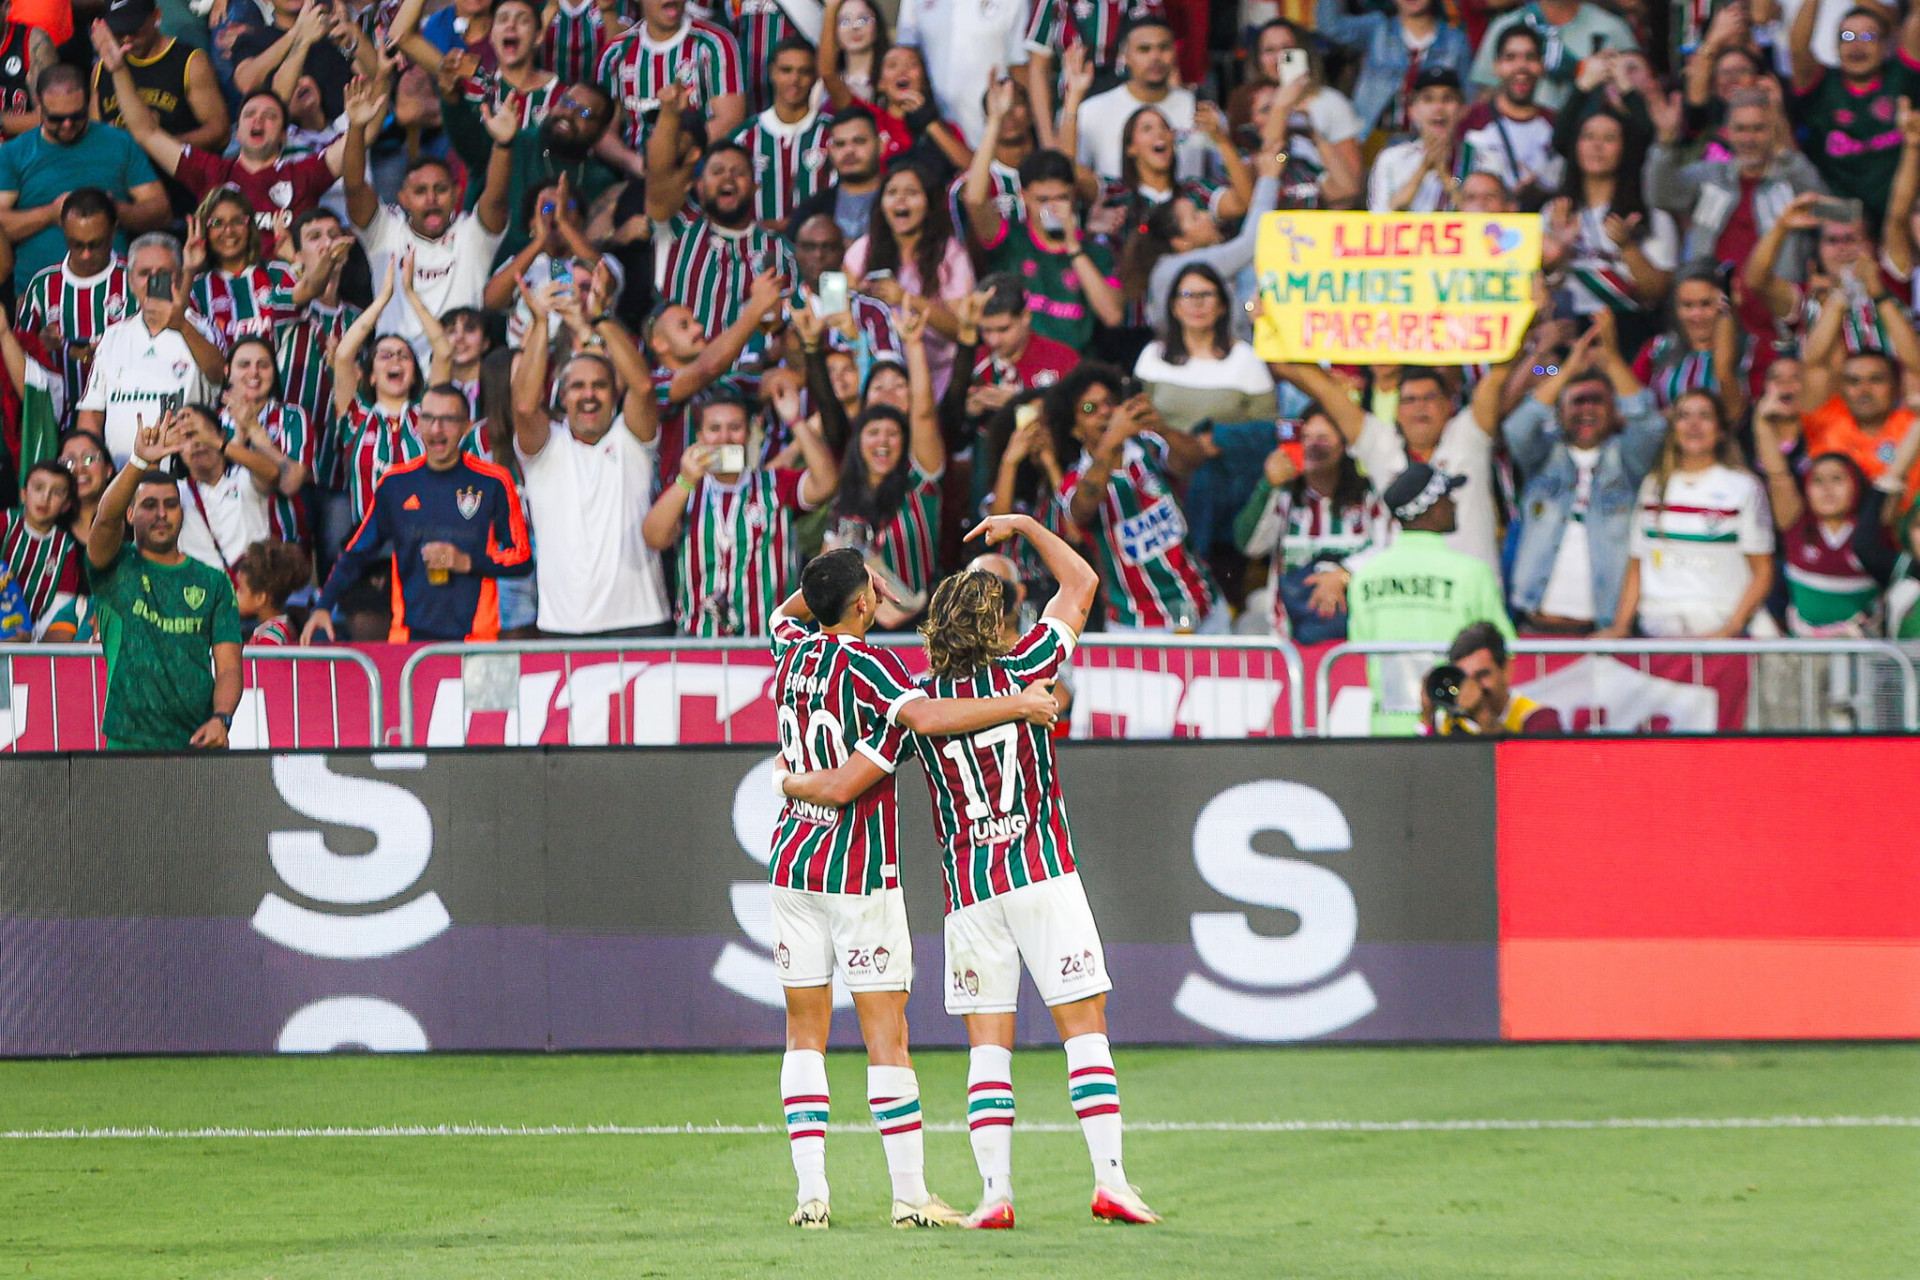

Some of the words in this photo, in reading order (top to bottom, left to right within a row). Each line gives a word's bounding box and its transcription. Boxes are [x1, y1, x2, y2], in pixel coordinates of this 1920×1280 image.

[1332, 222, 1464, 257] LUCAS
[1259, 268, 1414, 303] AMAMOS
[1362, 576, 1453, 600] SUNSET
[778, 704, 849, 774] 90
[943, 722, 1019, 820] 17
[795, 799, 837, 822] UNIG
[973, 814, 1027, 840] UNIG
[1190, 779, 1356, 987] S
[848, 948, 871, 968] Zé
[1060, 953, 1084, 976] Zé
